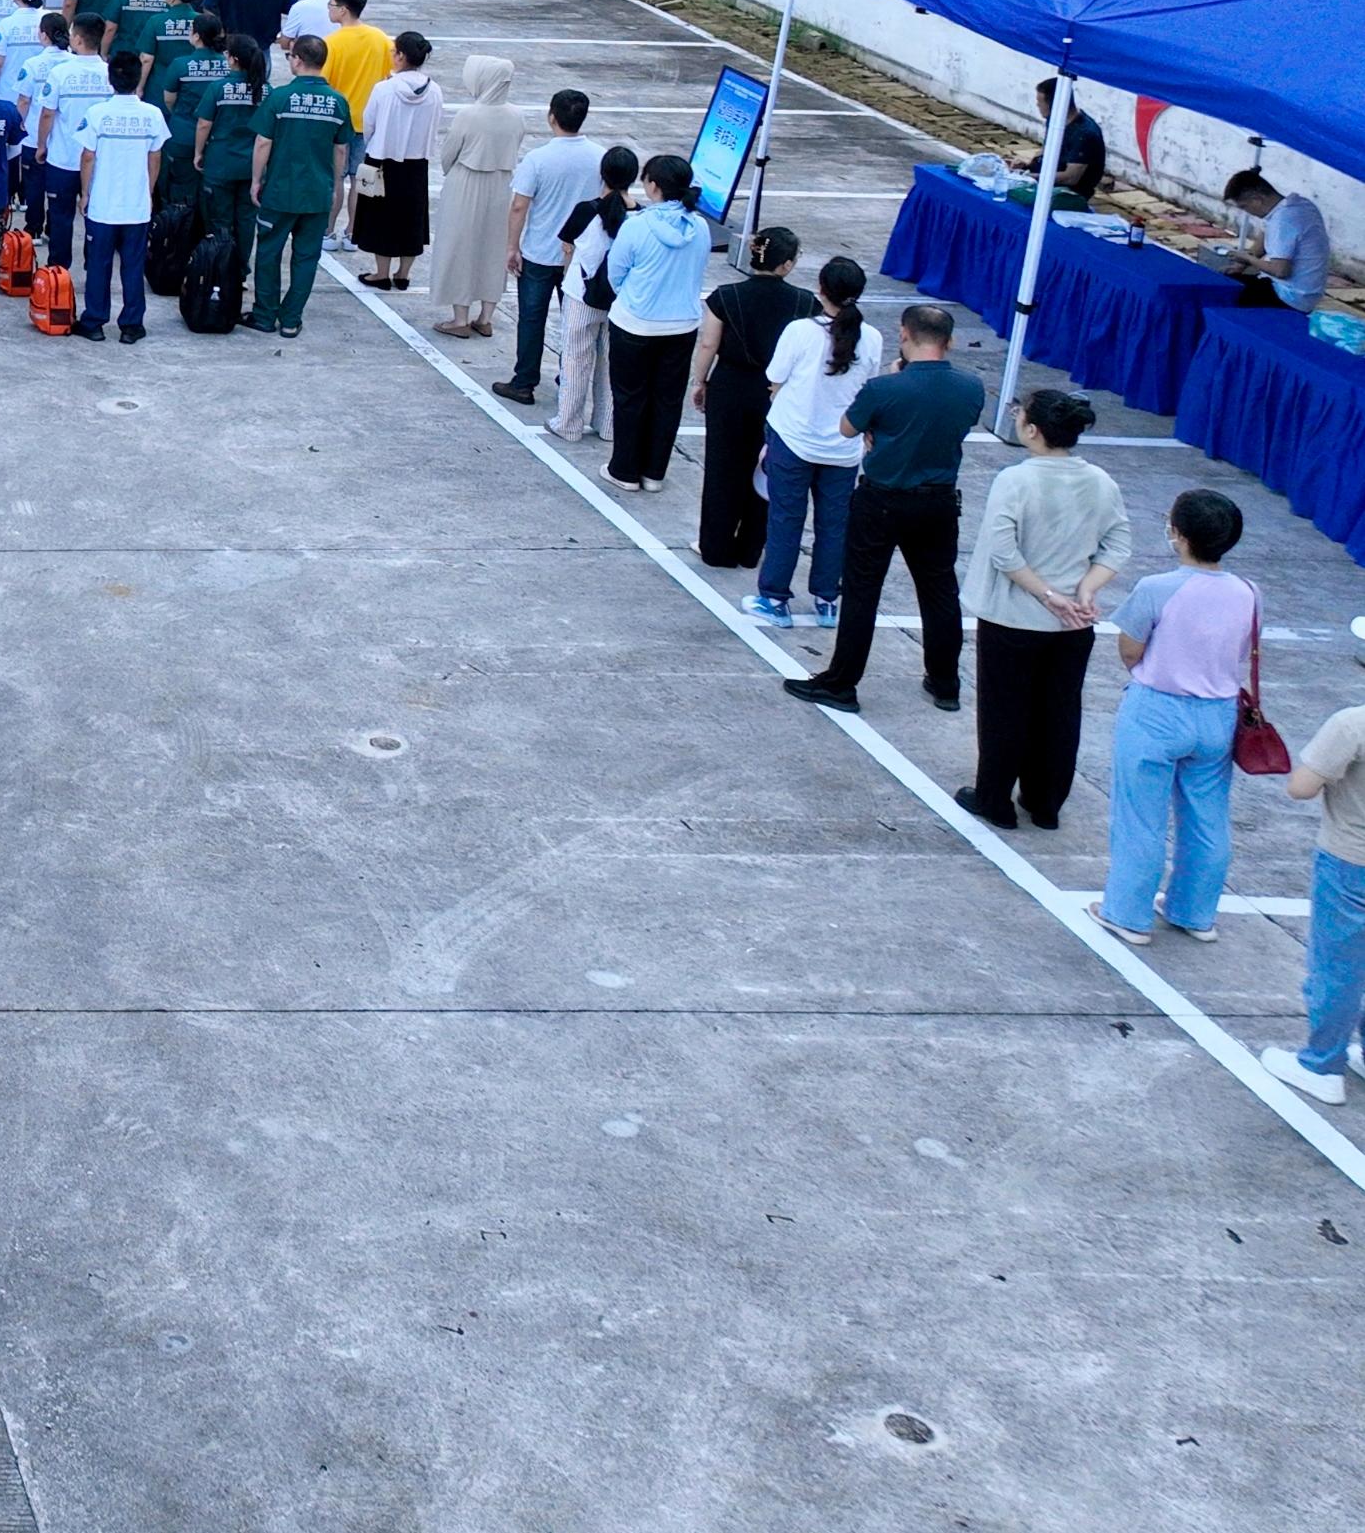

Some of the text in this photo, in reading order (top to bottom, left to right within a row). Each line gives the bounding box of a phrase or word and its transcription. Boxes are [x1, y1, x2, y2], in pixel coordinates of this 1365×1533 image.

[187, 59, 231, 71] 合浦卫生
[289, 93, 337, 109] 合浦卫生
